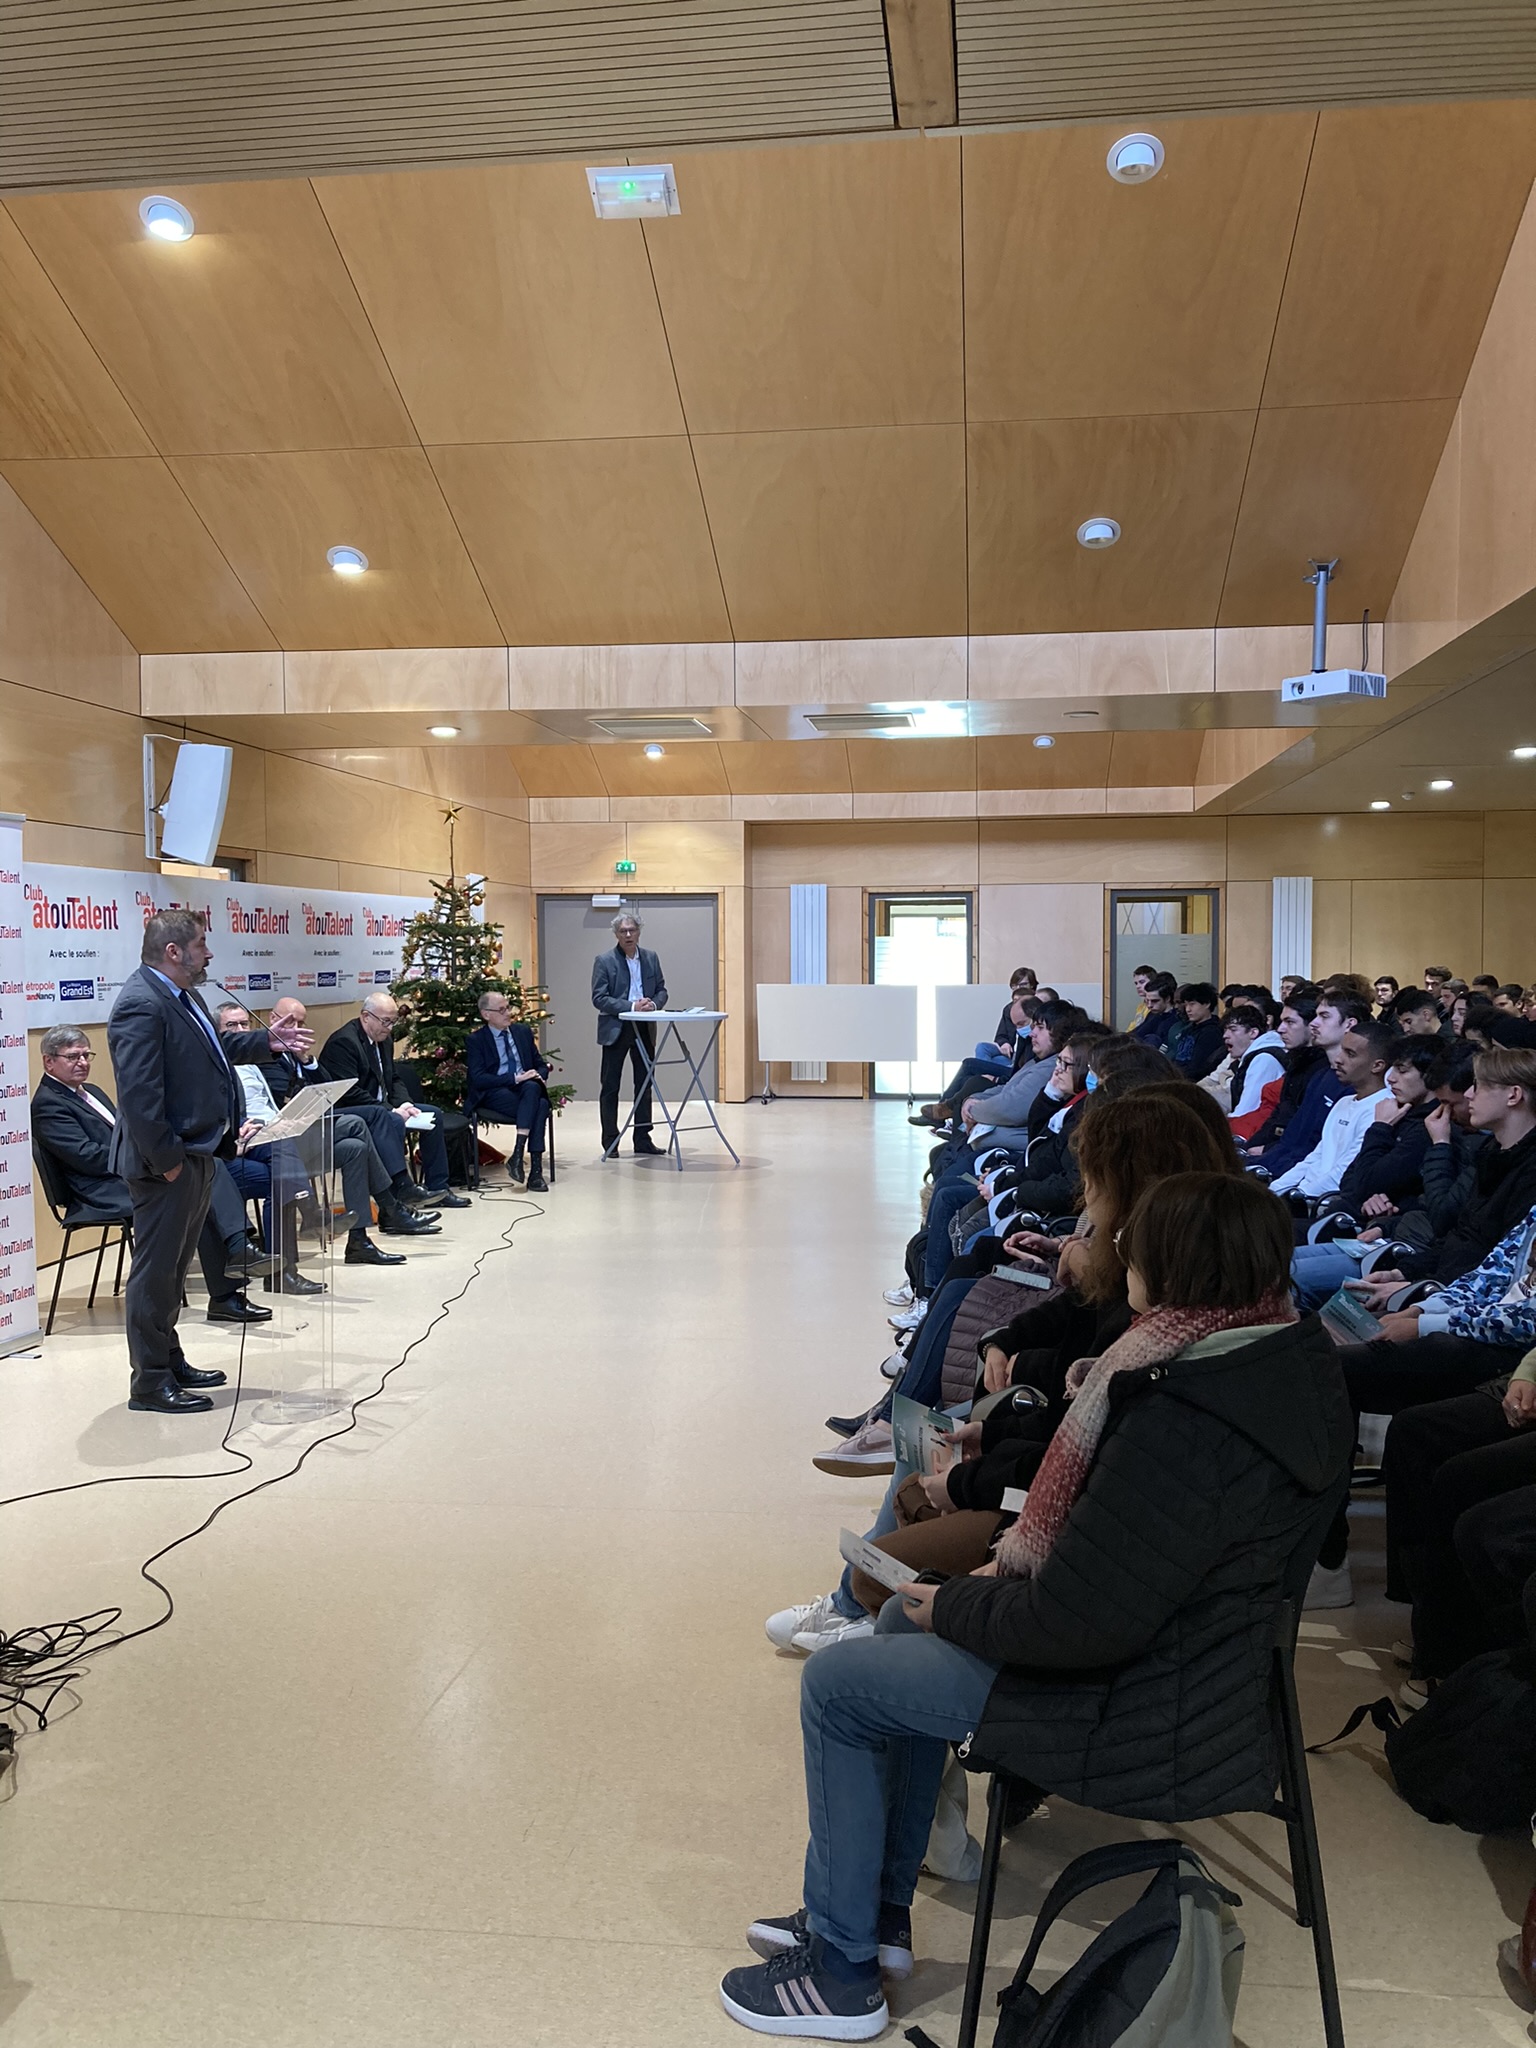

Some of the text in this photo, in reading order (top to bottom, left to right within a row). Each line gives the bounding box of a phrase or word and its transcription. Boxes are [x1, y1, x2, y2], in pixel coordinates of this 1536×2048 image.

[24, 884, 43, 901] Club
[135, 891, 151, 906] Club
[226, 897, 239, 911] Club
[33, 896, 119, 930] atouTalent
[231, 907, 290, 934] atouTalent
[306, 911, 354, 936] atouTalent
[49, 949, 67, 958] Avec
[68, 949, 75, 958] le
[61, 985, 93, 997] Grand Est
